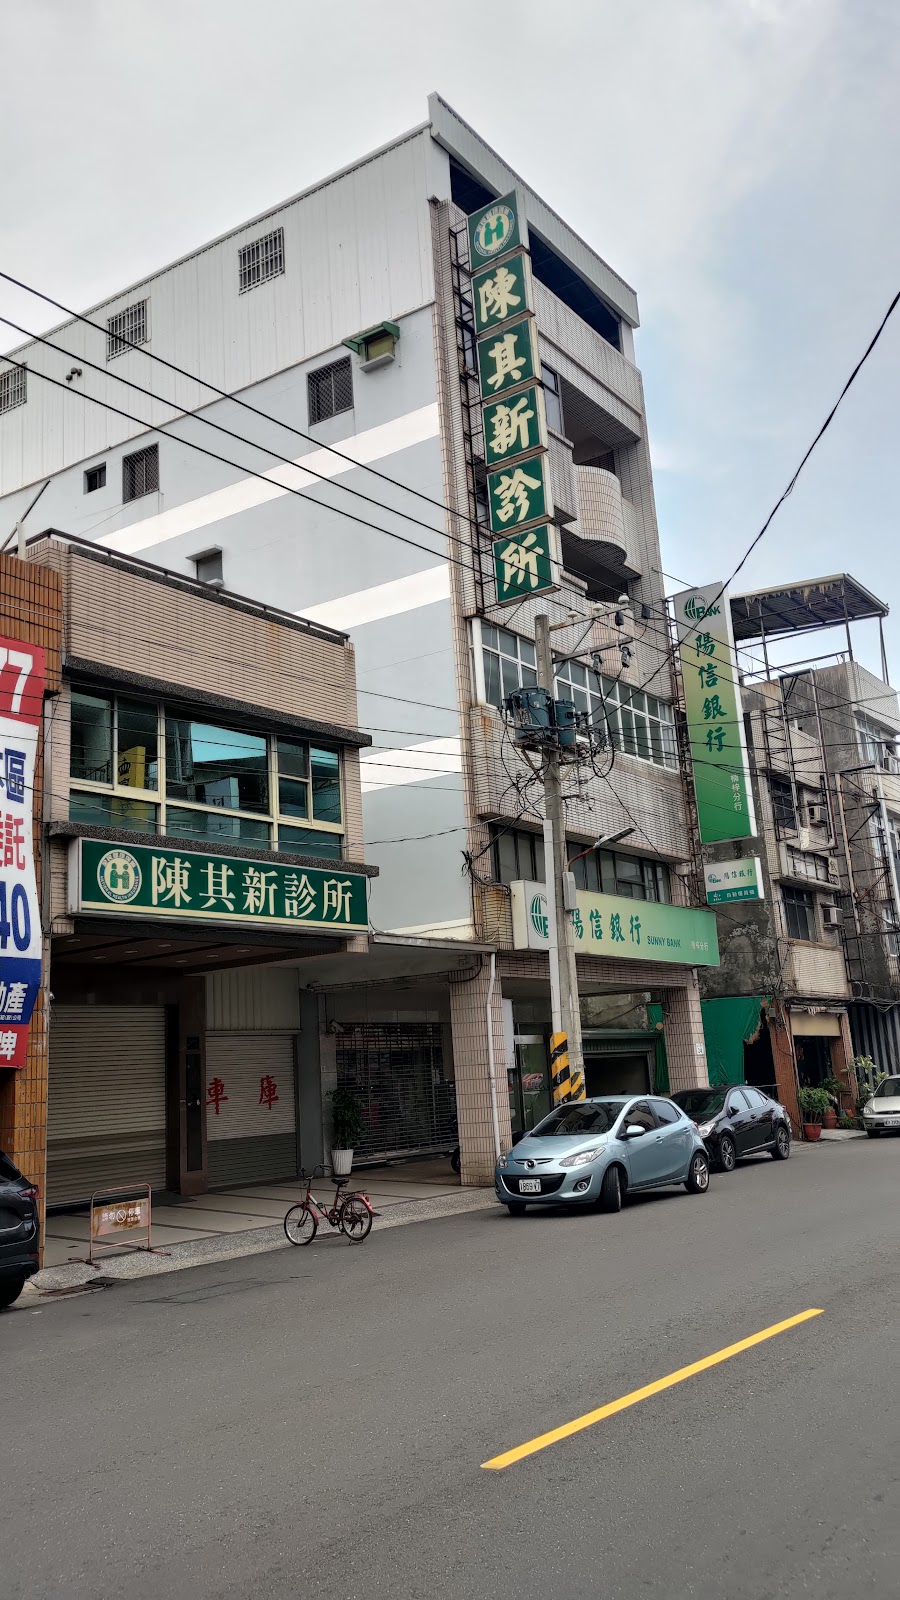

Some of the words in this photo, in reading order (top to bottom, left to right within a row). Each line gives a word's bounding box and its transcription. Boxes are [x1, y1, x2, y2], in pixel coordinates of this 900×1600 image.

[478, 266, 544, 592] 陳其新診所
[695, 631, 728, 753] 陽信銀行
[151, 855, 353, 923] 陳其新診所
[647, 935, 666, 947] SUNNY
[667, 937, 682, 948] BANK
[206, 1074, 279, 1116] 車庫
